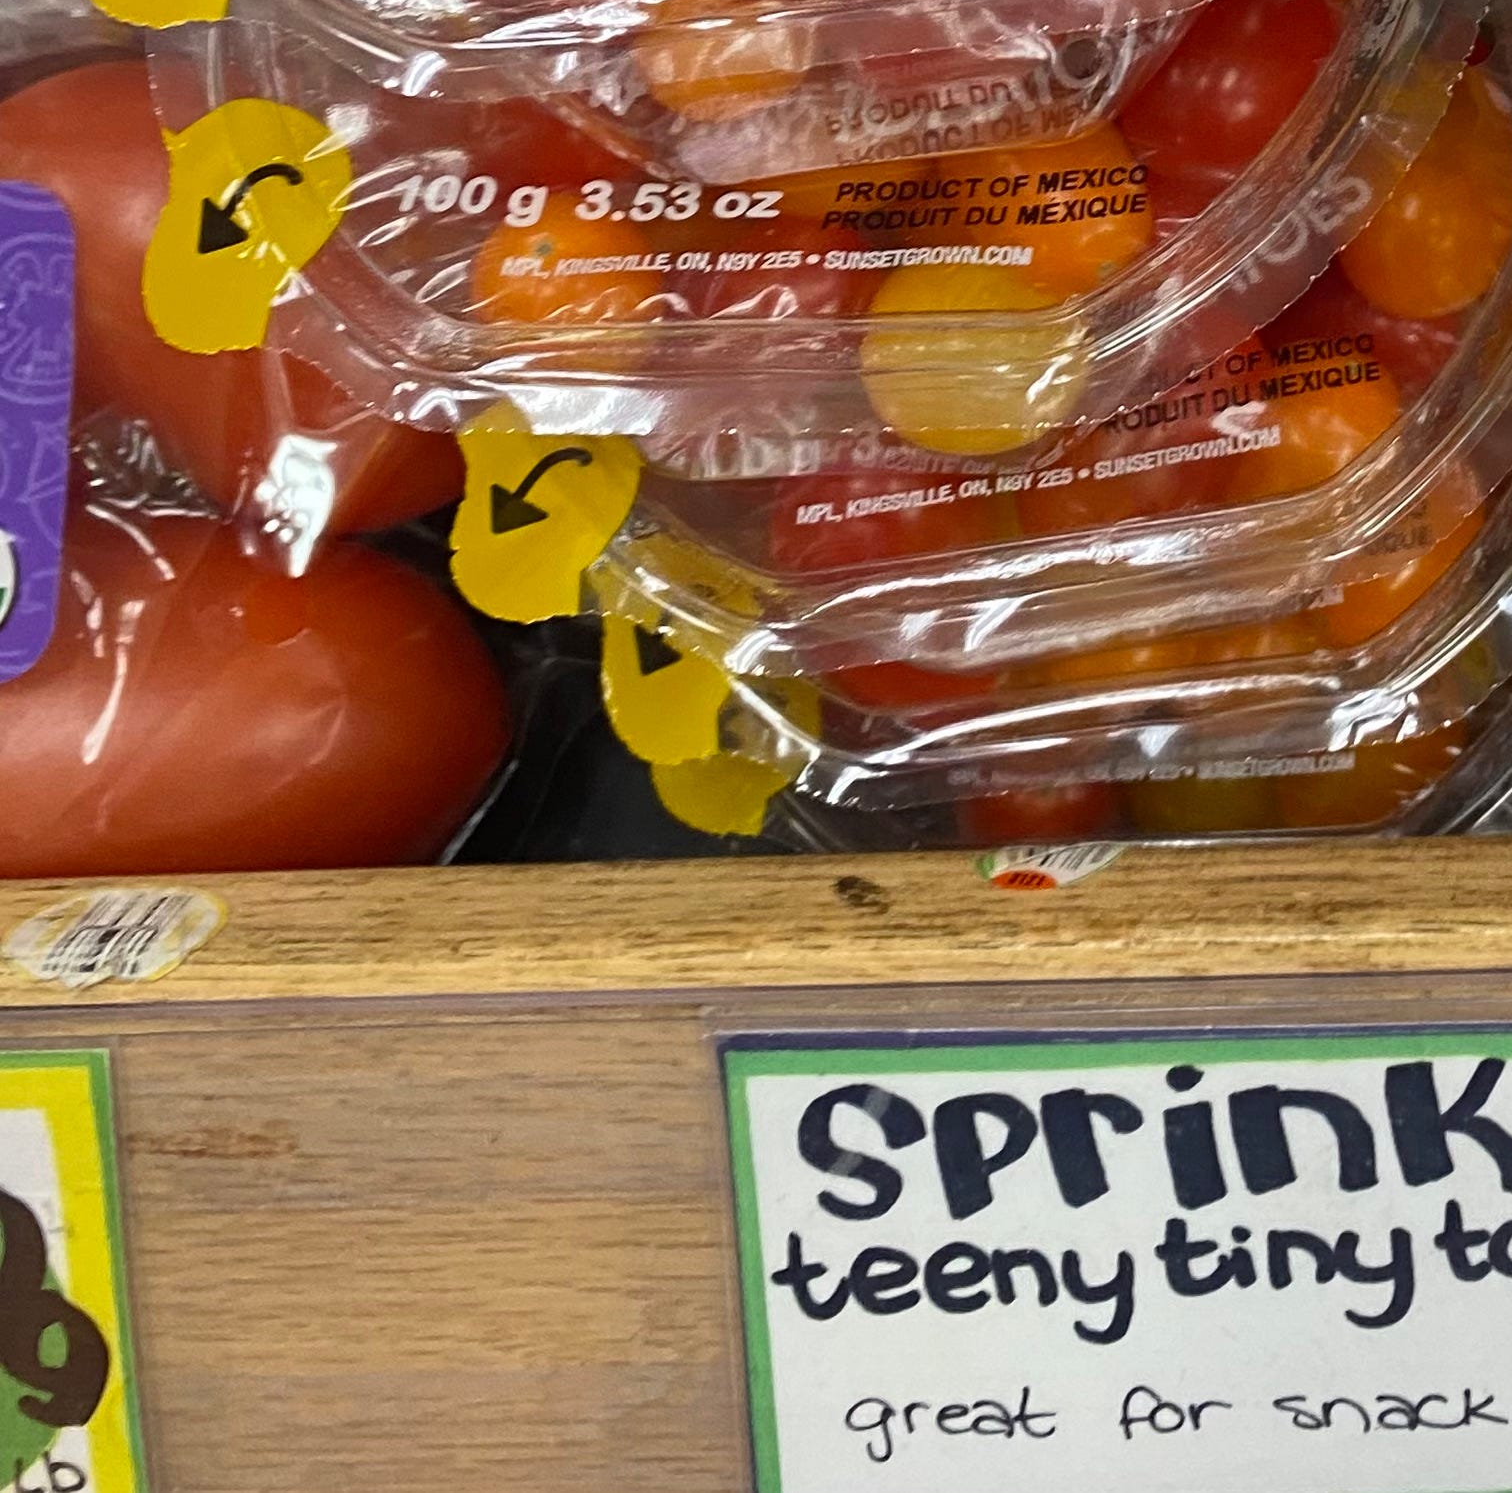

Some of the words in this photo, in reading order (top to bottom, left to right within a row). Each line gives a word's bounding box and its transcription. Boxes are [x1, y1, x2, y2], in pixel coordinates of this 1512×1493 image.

[397, 173, 498, 214] 100
[504, 184, 550, 228] g
[574, 179, 701, 223] 3.53
[712, 189, 785, 220] oz
[835, 178, 982, 203] PRODUCT
[989, 175, 1030, 198] OF
[1036, 163, 1149, 194] MEXICO
[821, 205, 952, 232] PRODUIT
[964, 204, 1007, 227] DU
[554, 253, 674, 279] KINGSVILLE,
[760, 250, 803, 270] 2E5
[823, 245, 1035, 271] SUNSETGROWN.COM
[1225, 350, 1266, 377] OF
[1270, 332, 1375, 369] MEXICO
[845, 483, 956, 519] KINGSVILLE,
[1037, 466, 1074, 490] 2E5
[1094, 423, 1282, 481] SUNSETGROWN.COM
[772, 1230, 1138, 1345] teeny
[1154, 1216, 1414, 1328] tiny
[845, 1387, 1059, 1462] great
[1119, 1391, 1232, 1441] for
